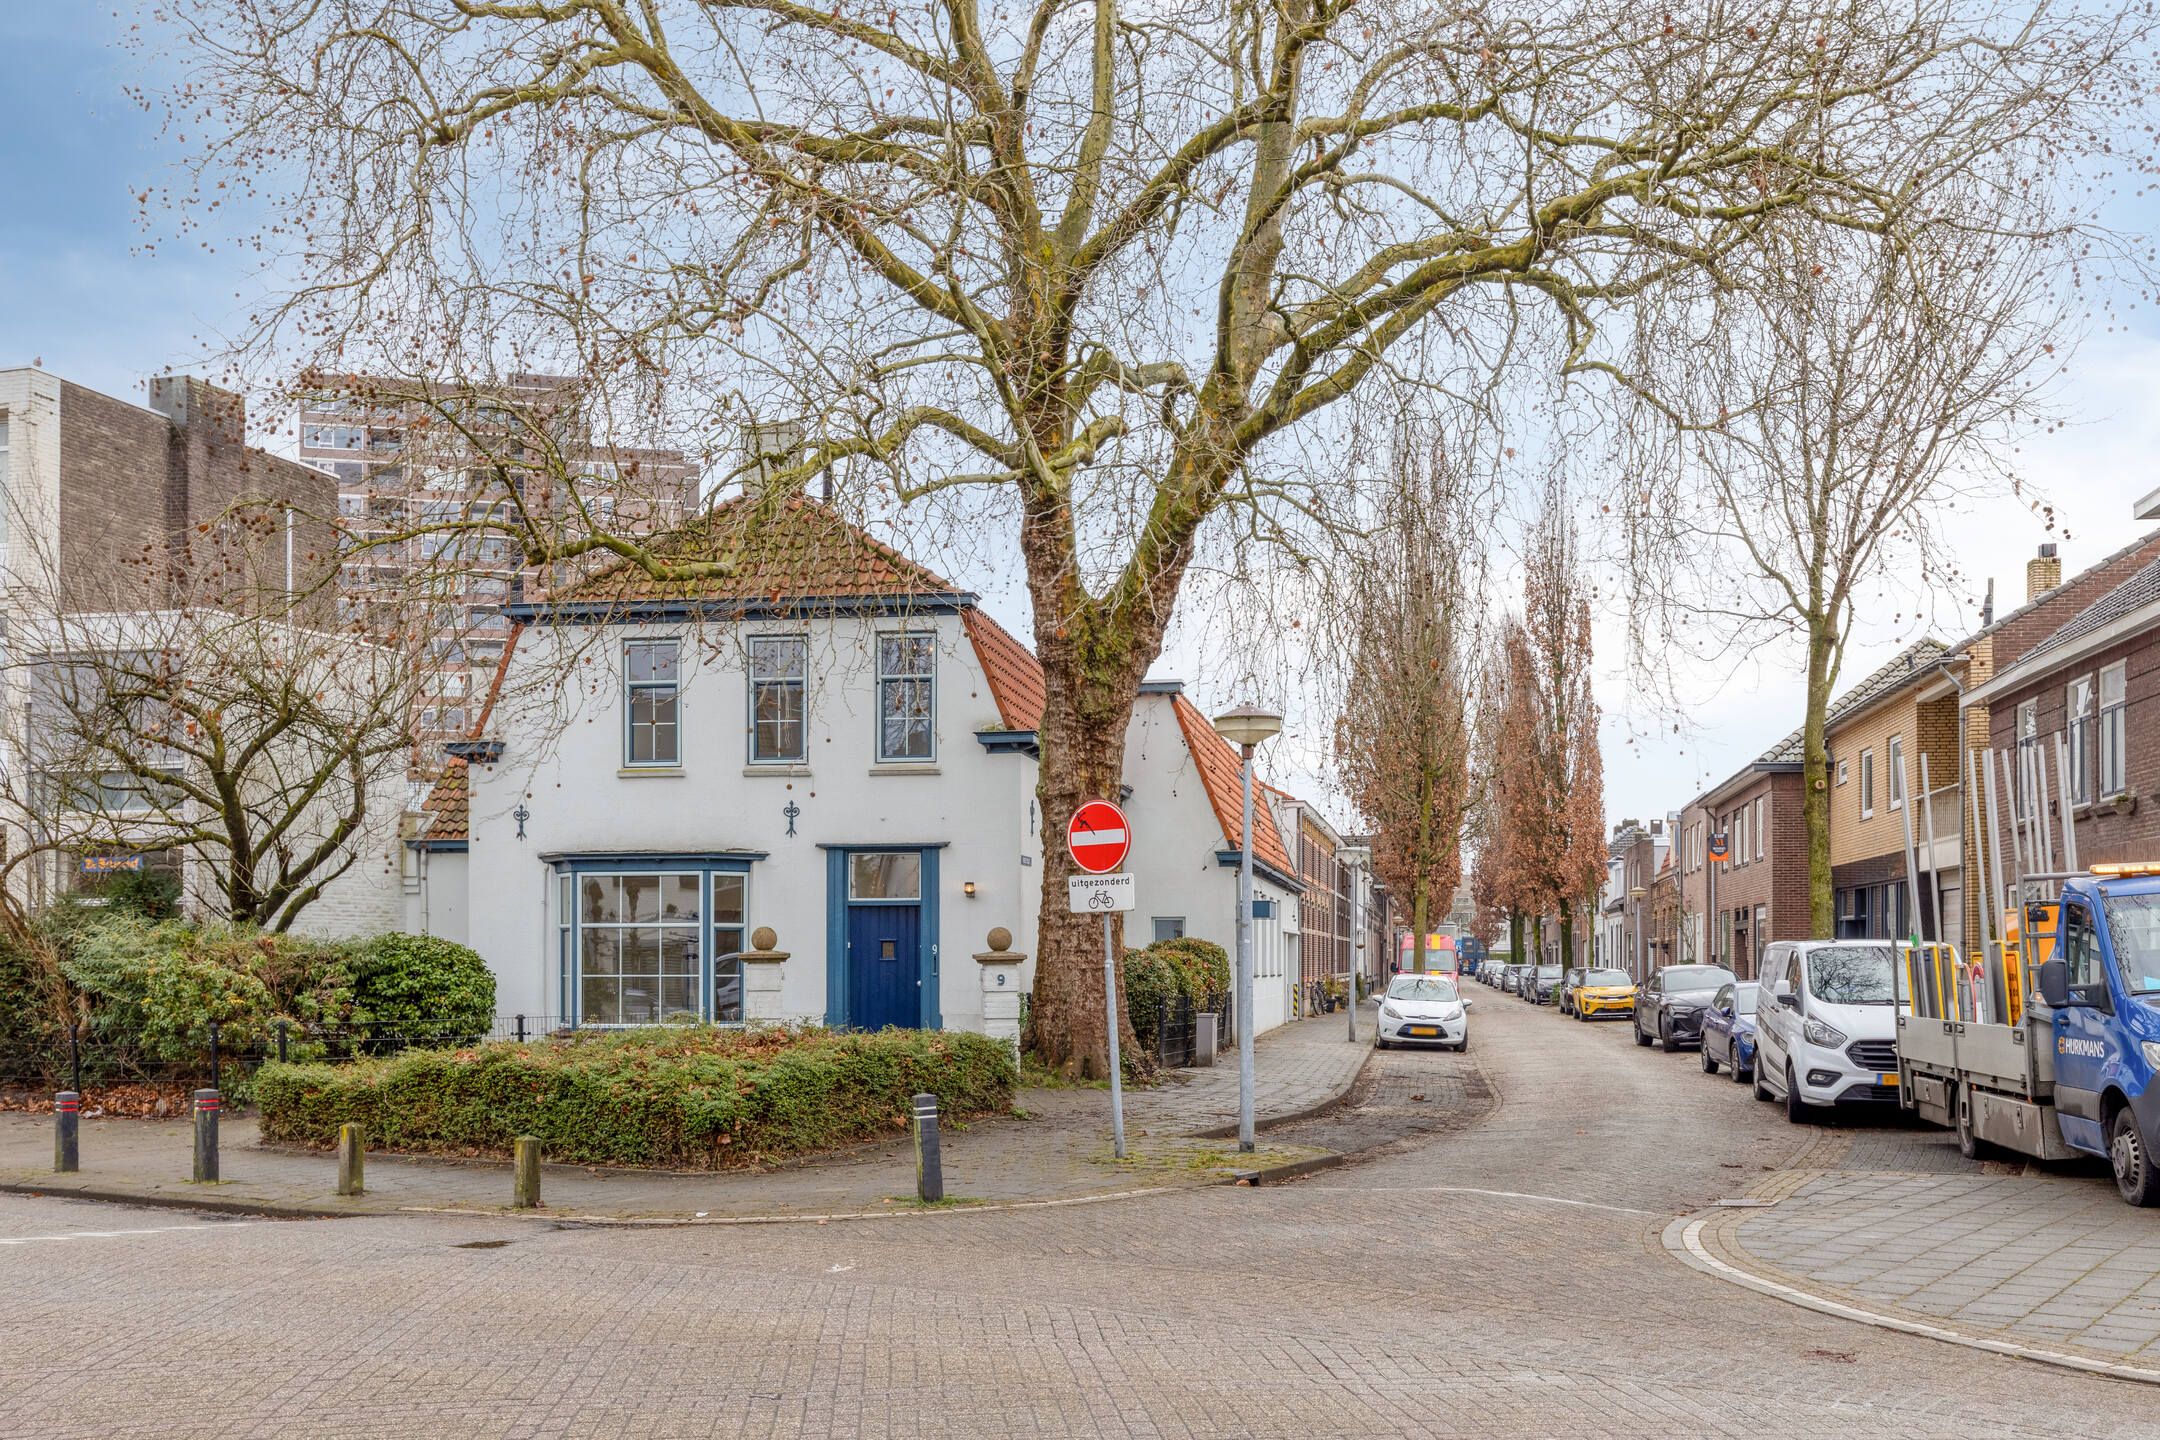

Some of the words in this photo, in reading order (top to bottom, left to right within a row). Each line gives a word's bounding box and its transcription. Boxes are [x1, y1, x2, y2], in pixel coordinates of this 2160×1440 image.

[1071, 877, 1130, 888] uitgezonderd
[932, 944, 938, 954] 9
[997, 974, 1006, 986] 9
[2065, 1037, 2105, 1058] HURKMANS
